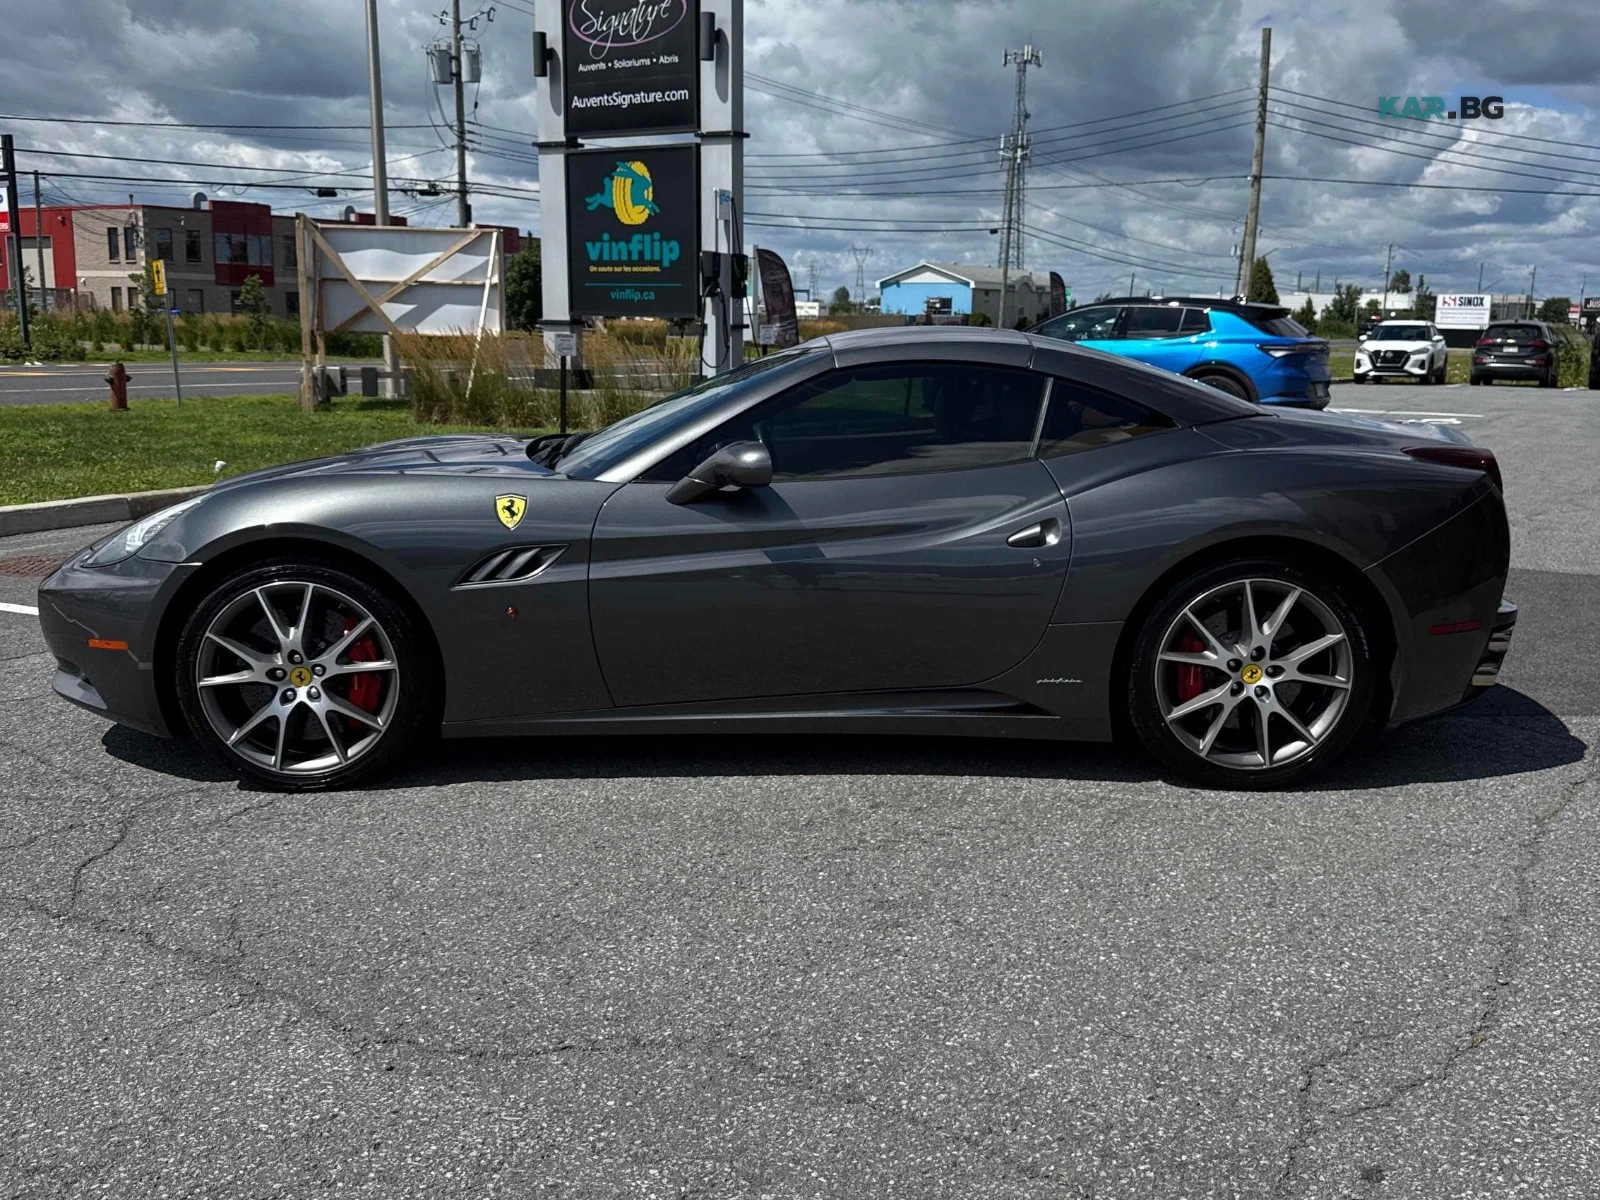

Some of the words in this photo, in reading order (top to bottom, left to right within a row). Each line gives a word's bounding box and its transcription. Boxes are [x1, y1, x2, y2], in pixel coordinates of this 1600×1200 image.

[580, 0, 672, 60] Signature
[578, 61, 606, 73] Auvents
[613, 57, 651, 70] Solariums
[659, 54, 679, 65] Abris
[571, 88, 689, 110] AuventsSignature.com
[585, 231, 681, 268] vinflip
[598, 265, 613, 273] saute
[610, 288, 655, 303] vinflip.ca
[1457, 296, 1485, 307] SINOX
